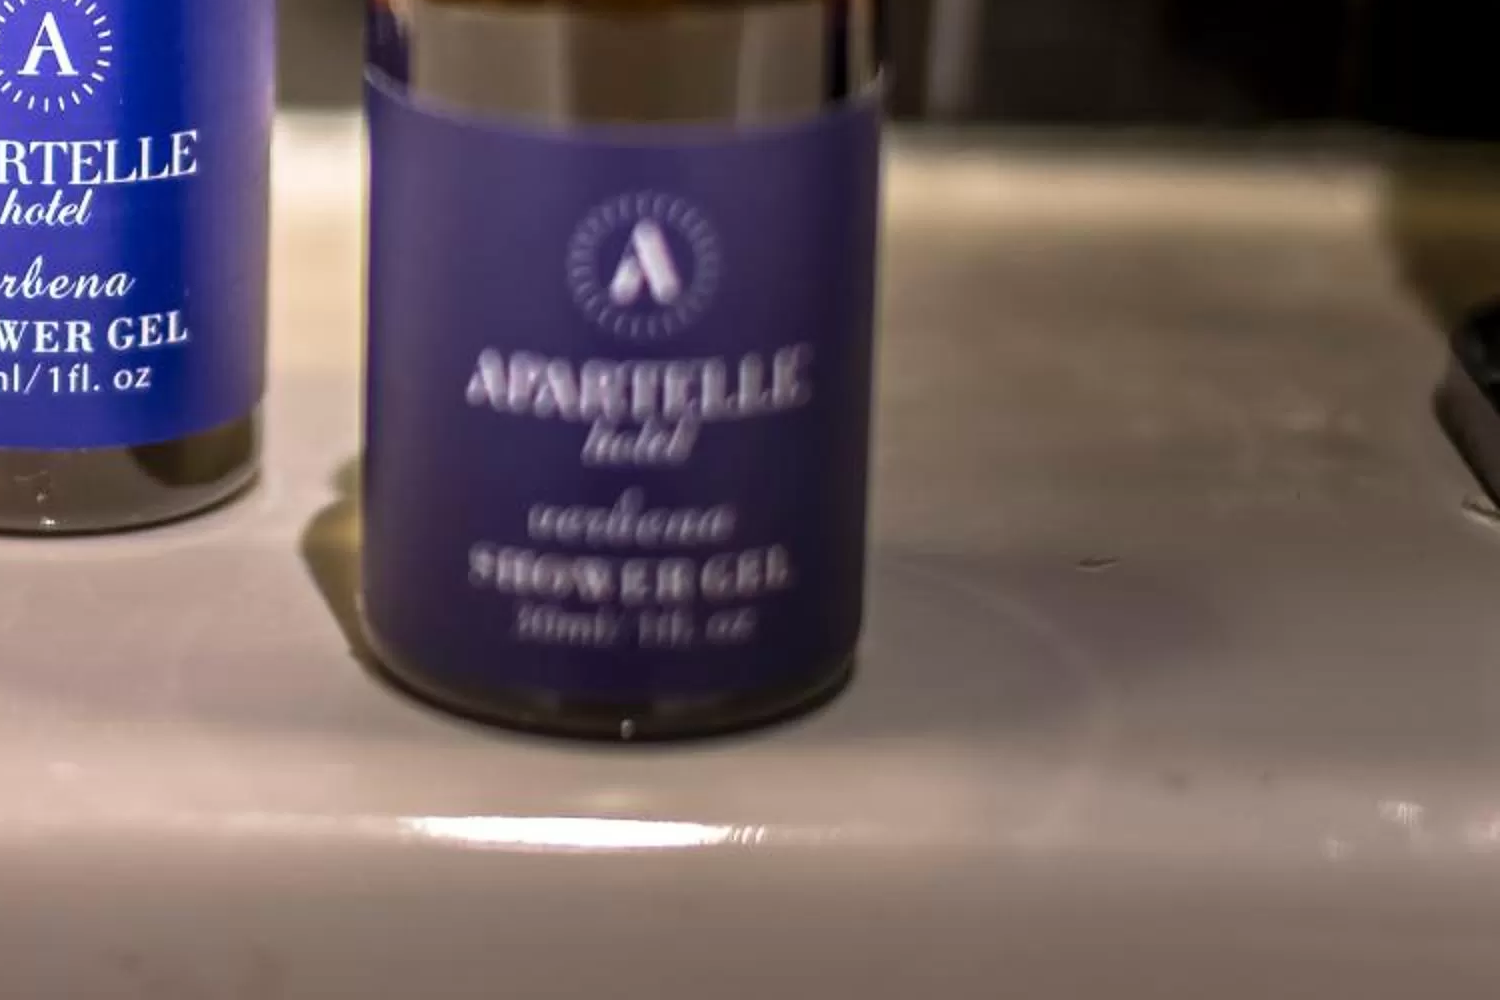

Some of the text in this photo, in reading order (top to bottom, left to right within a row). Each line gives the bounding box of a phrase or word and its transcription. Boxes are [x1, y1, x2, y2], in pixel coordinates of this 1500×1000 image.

[17, 11, 77, 76] A
[0, 189, 92, 225] hotel
[610, 217, 680, 304] A
[107, 309, 189, 350] GEL
[113, 365, 152, 389] oz
[466, 342, 813, 422] APARTELLE
[468, 542, 791, 605] SHOWER GEL
